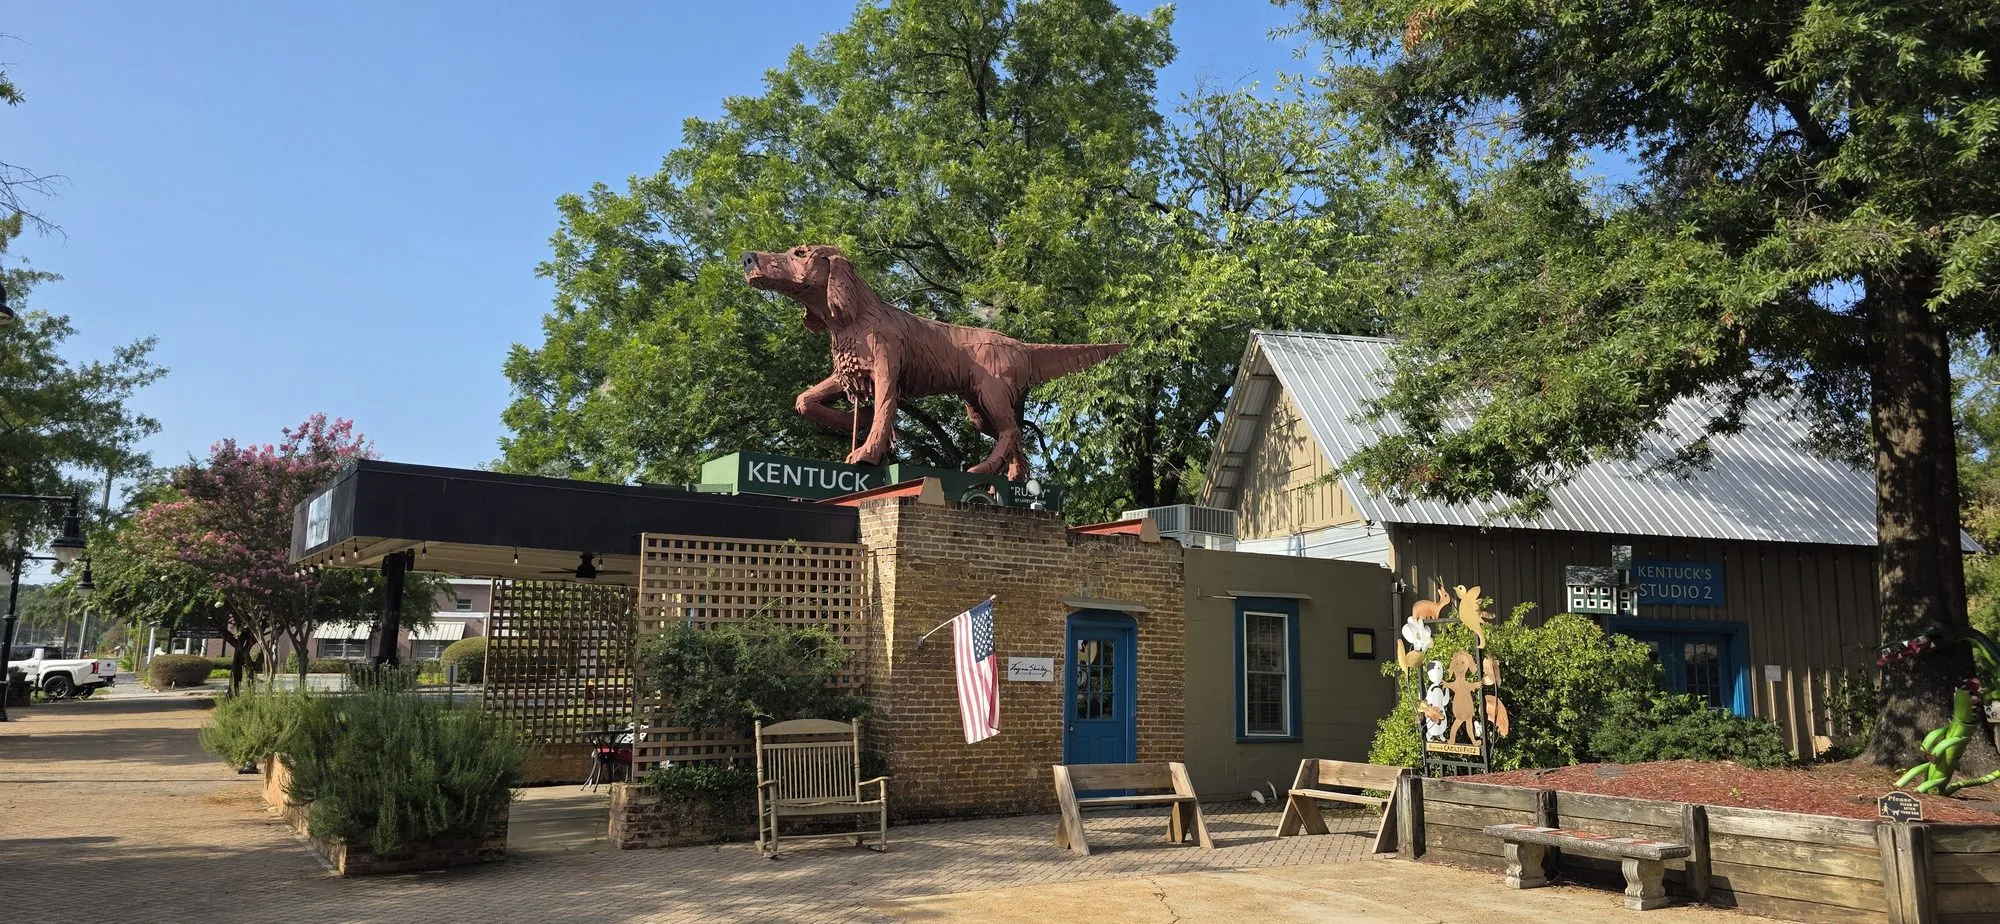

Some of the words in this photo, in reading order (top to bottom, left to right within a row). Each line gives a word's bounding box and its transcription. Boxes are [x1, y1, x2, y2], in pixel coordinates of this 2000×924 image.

[748, 461, 871, 492] KENTUCK
[1638, 566, 1712, 580] KENTUCK'S
[1639, 584, 1699, 599] STUDIO
[1703, 586, 1713, 600] 2
